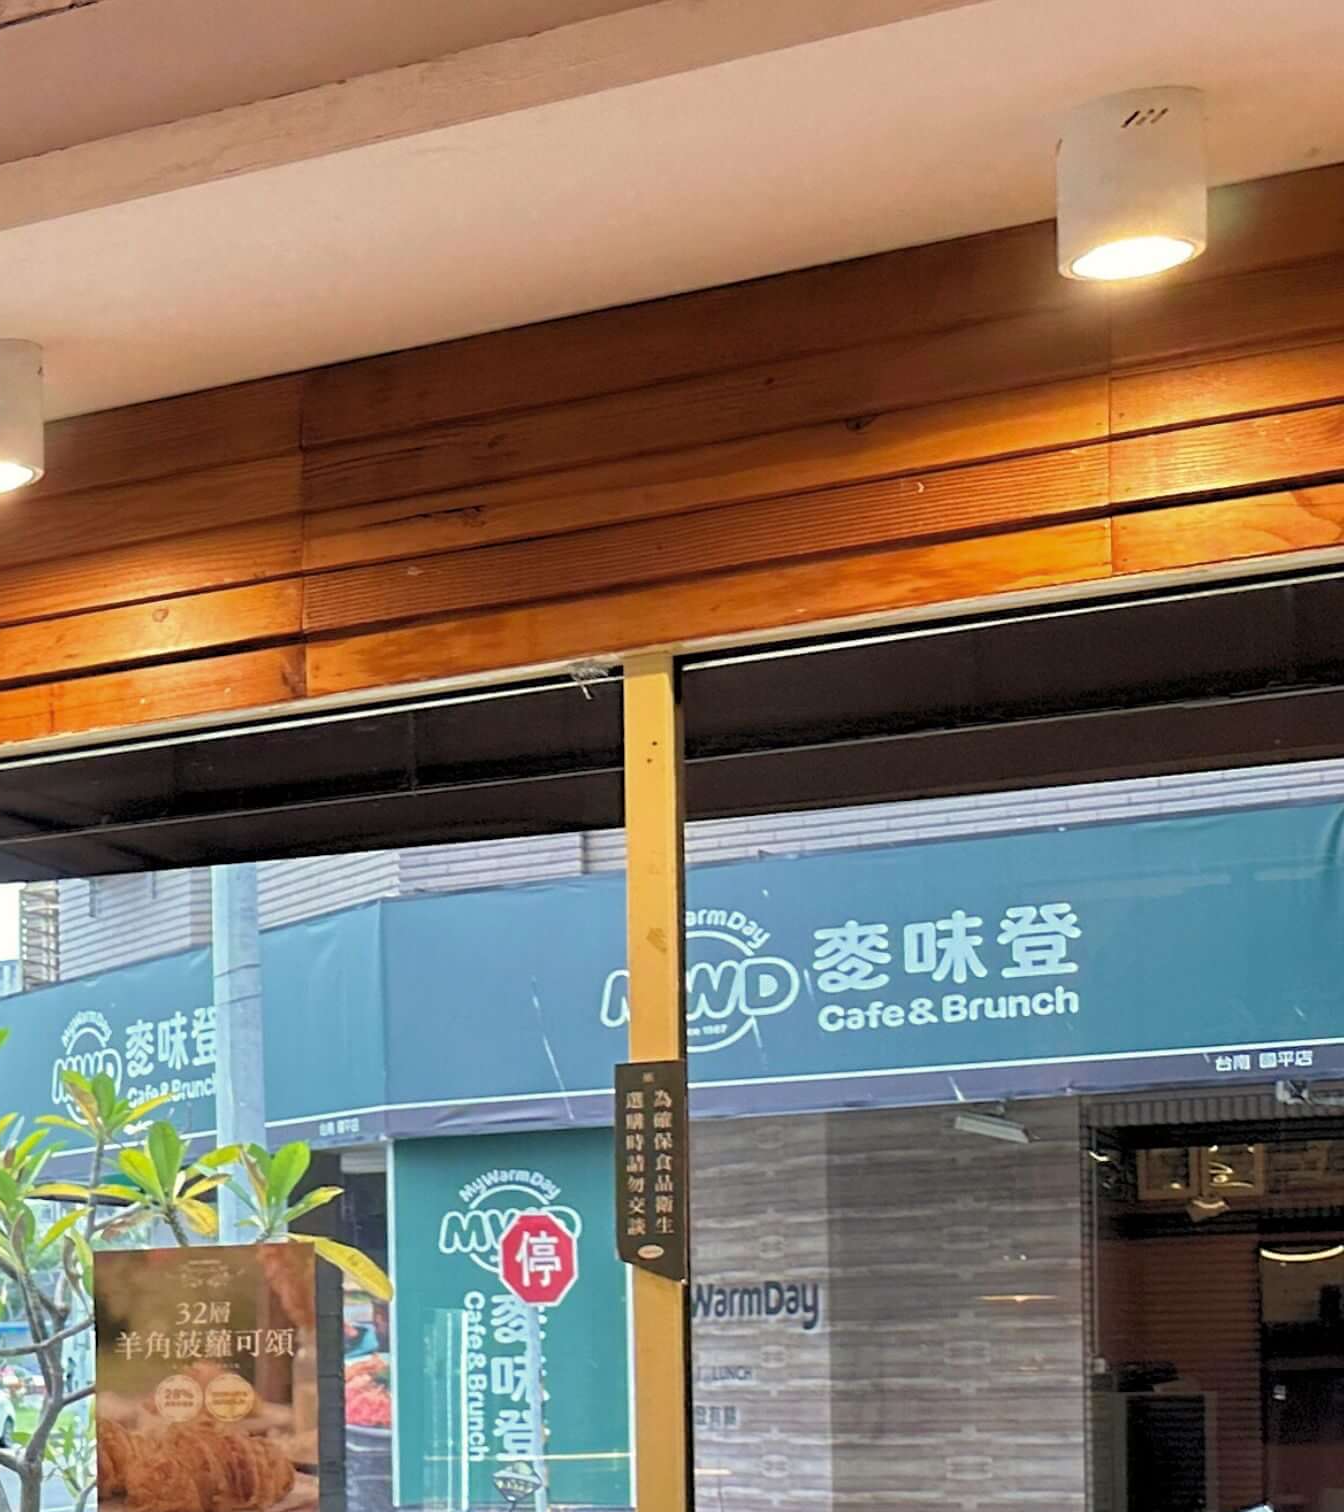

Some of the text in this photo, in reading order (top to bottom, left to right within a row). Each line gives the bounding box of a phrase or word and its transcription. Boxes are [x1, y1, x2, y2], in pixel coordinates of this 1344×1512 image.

[814, 902, 1081, 993] 麥味登
[515, 1230, 562, 1288] 停
[176, 1302, 231, 1325] 32層
[115, 1328, 297, 1360] 羊角菠蘿可頌
